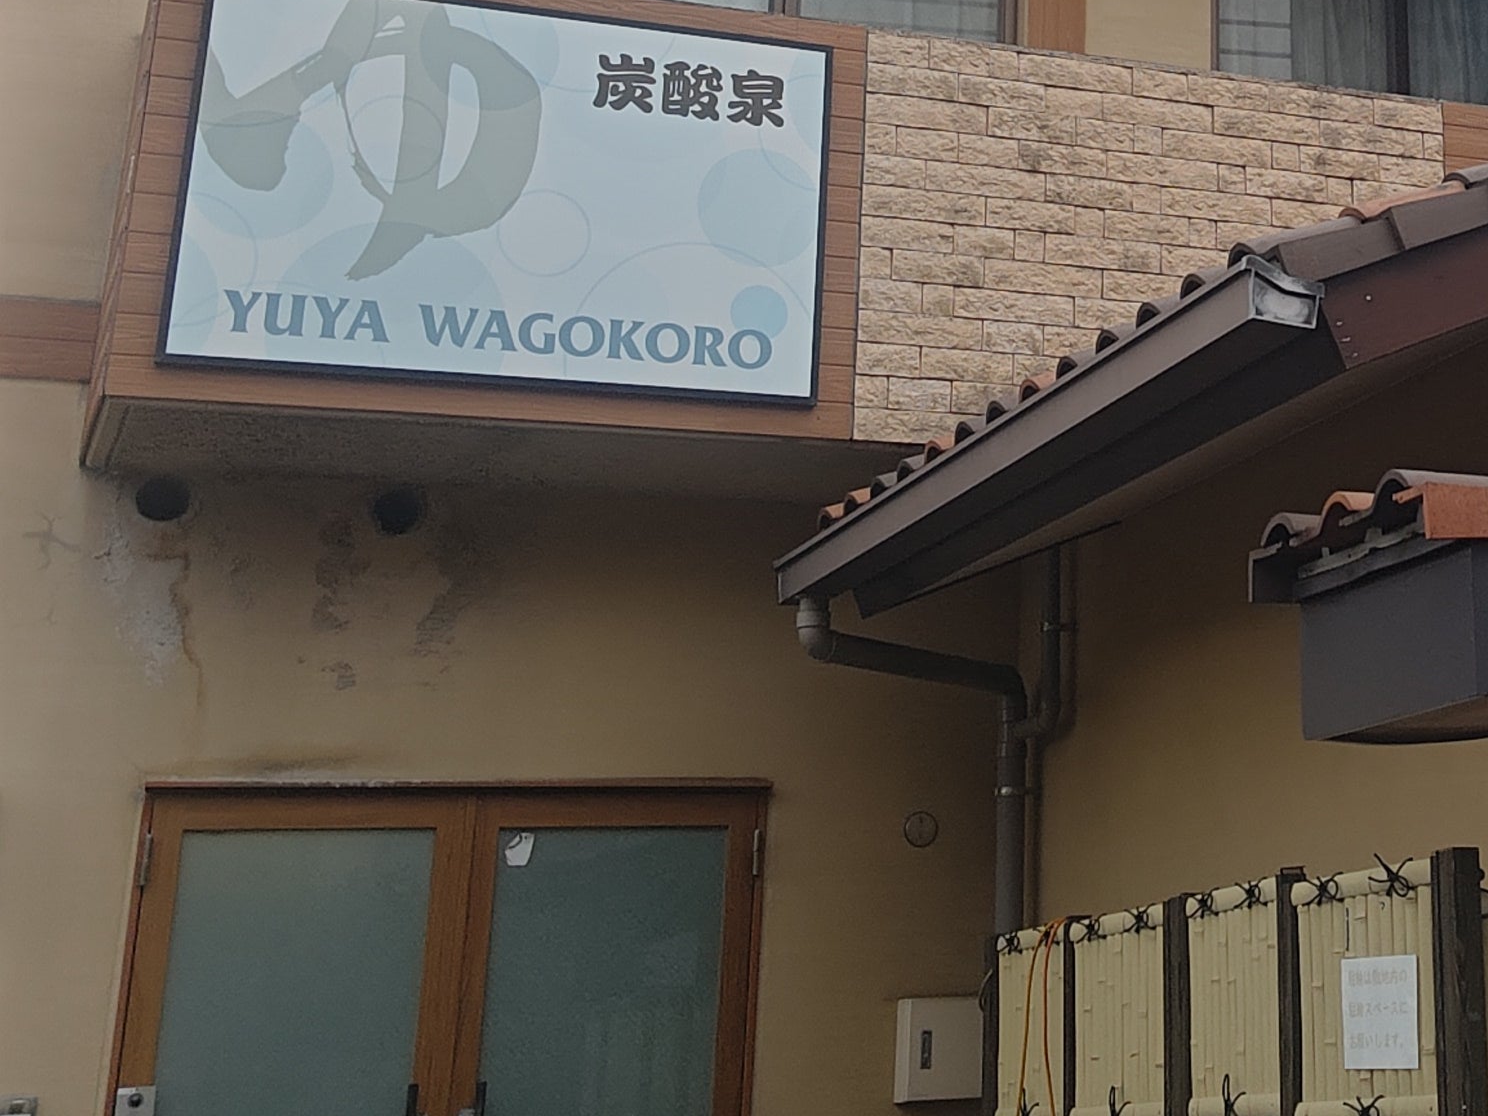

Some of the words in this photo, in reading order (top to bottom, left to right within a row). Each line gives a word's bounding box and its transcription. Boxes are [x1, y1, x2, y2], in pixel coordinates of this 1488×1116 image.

[593, 52, 787, 128] 炭酸泉
[223, 289, 391, 344] YUYA
[419, 303, 773, 371] WAGOKORO
